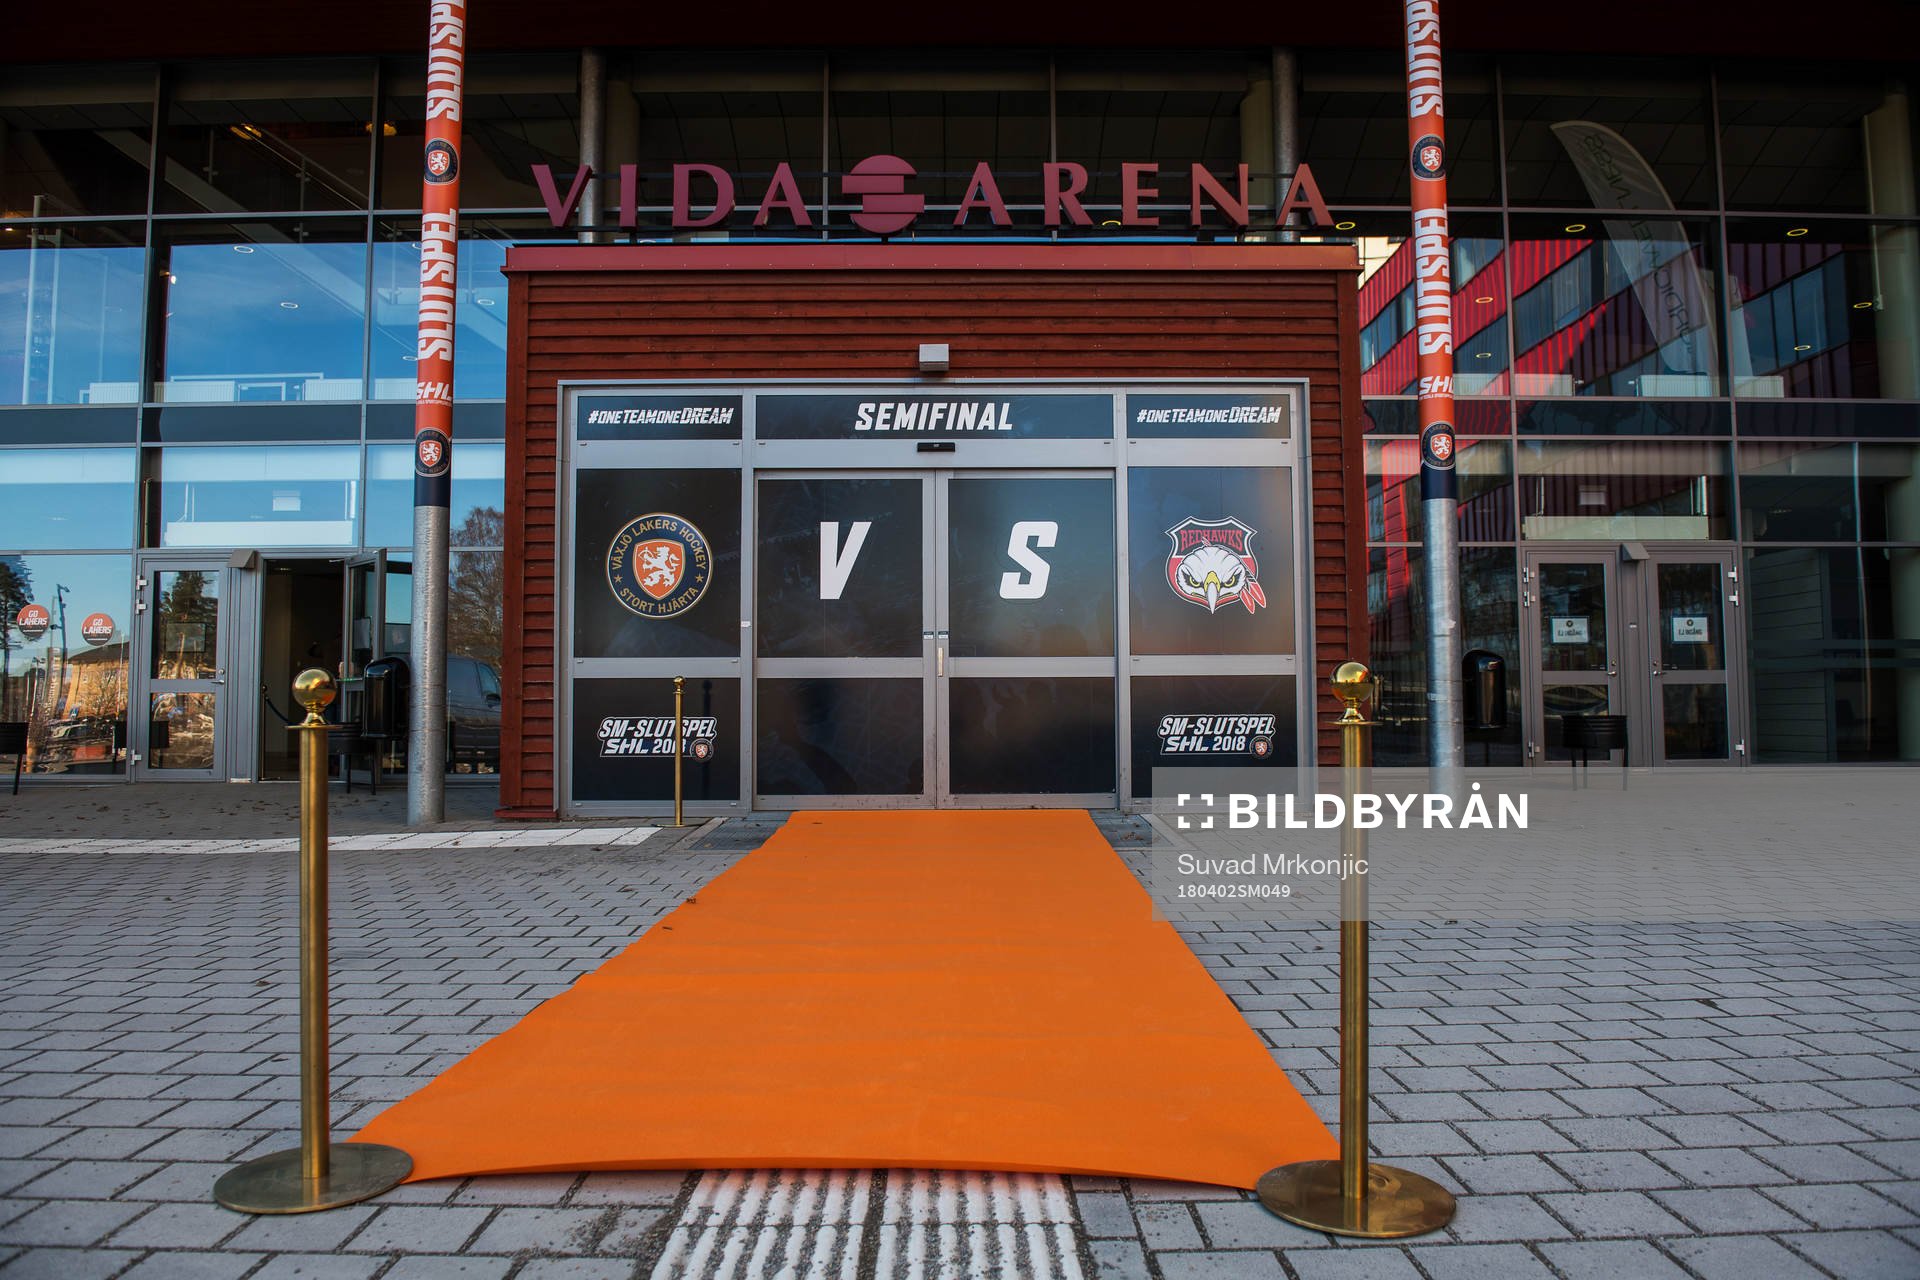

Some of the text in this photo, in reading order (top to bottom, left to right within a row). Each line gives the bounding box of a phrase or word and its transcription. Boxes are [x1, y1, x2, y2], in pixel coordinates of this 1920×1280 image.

[426, 0, 464, 122] SLUTSP
[1406, 0, 1444, 118] SLUTSP
[531, 162, 1336, 230] VIDA ARENA
[418, 208, 457, 361] SLUTSPEL
[1414, 203, 1453, 356] SLUTSPEL
[416, 382, 453, 401] SHL
[588, 407, 735, 425] #ONETEAMONEDREAM
[854, 402, 1014, 431] SEMIFINAL
[1137, 406, 1282, 424] #ONETEAMONEDREAM
[611, 519, 706, 570] VÄXJÖ LAKERS HOCKEY
[1180, 529, 1243, 552] REDHAWKS
[820, 521, 1059, 600] V S
[620, 587, 699, 614] STORT HJÄRTA
[1159, 717, 1274, 735] SM-SLUTSPEL
[604, 738, 648, 754] SHL
[1164, 736, 1246, 752] SHL 2018
